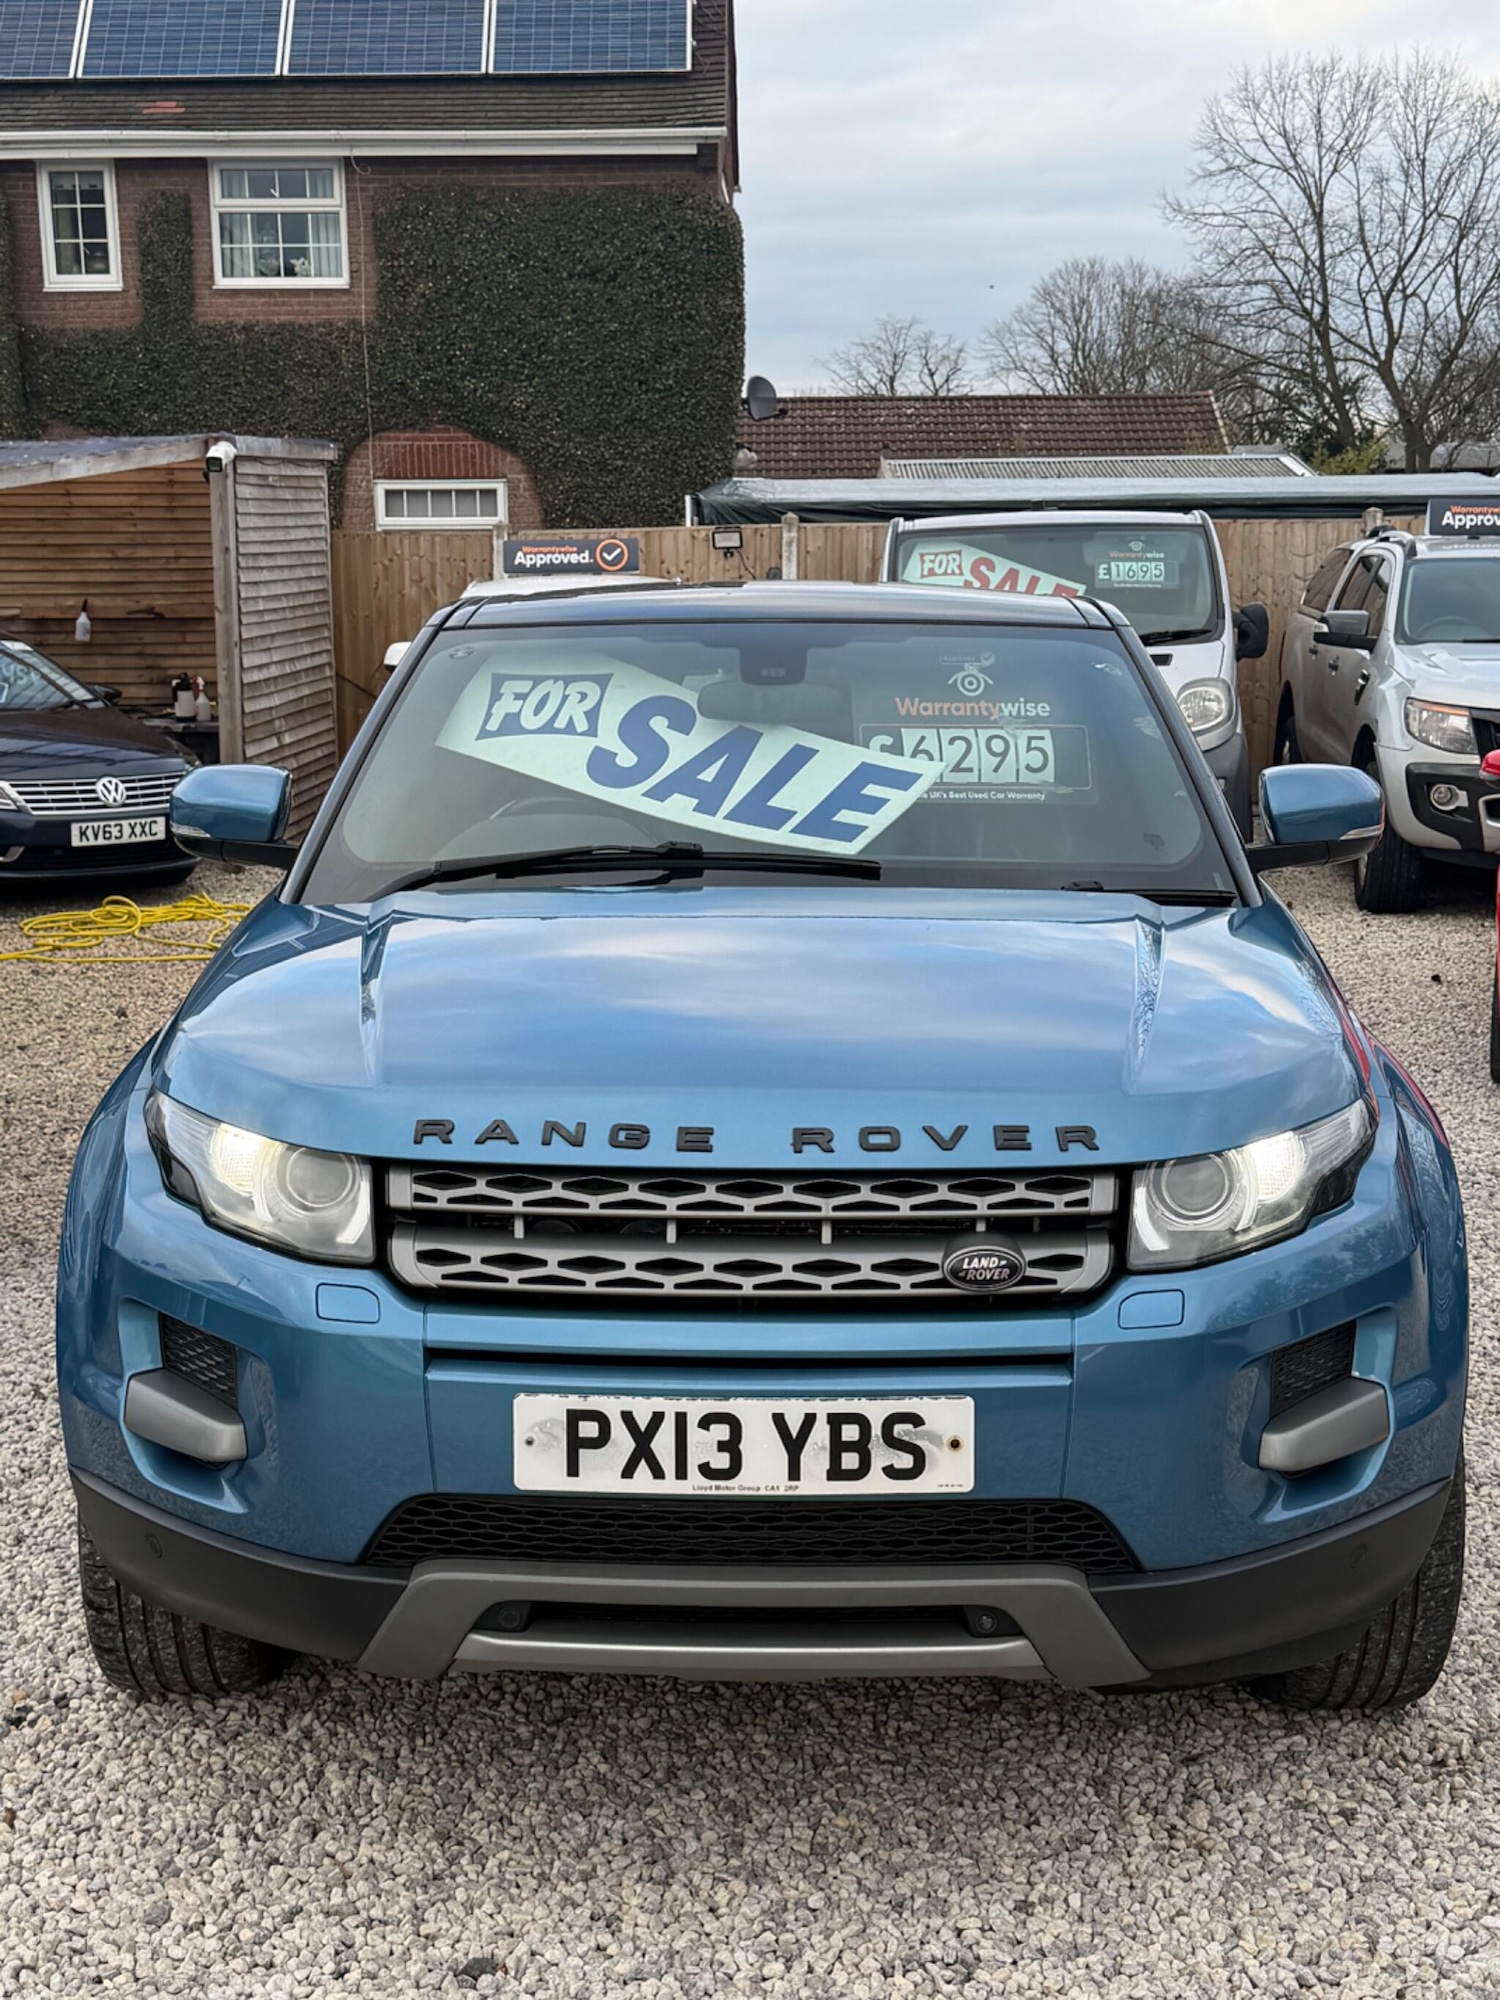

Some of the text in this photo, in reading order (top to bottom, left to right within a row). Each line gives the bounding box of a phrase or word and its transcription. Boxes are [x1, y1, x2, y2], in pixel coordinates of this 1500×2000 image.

[514, 549, 594, 568] Approved.
[922, 552, 961, 576] FOR
[1098, 563, 1163, 580] £1695
[485, 679, 592, 733] FOR
[895, 698, 1050, 721] Warrantywise
[586, 695, 924, 844] SALE
[949, 791, 966, 799] Best
[968, 791, 988, 799] Used
[990, 791, 1005, 799] Car
[1007, 791, 1046, 801] Warranty
[79, 820, 158, 843] KV63 XXC
[413, 1118, 1100, 1154] RANGE ROVER
[962, 1256, 999, 1269] LAND
[966, 1267, 1010, 1280] ROVER
[565, 1408, 926, 1482] PX13 YBS
[692, 1484, 713, 1492] Lloyd
[714, 1484, 736, 1492] Motor
[737, 1484, 761, 1492] Group
[764, 1484, 780, 1492] CA1
